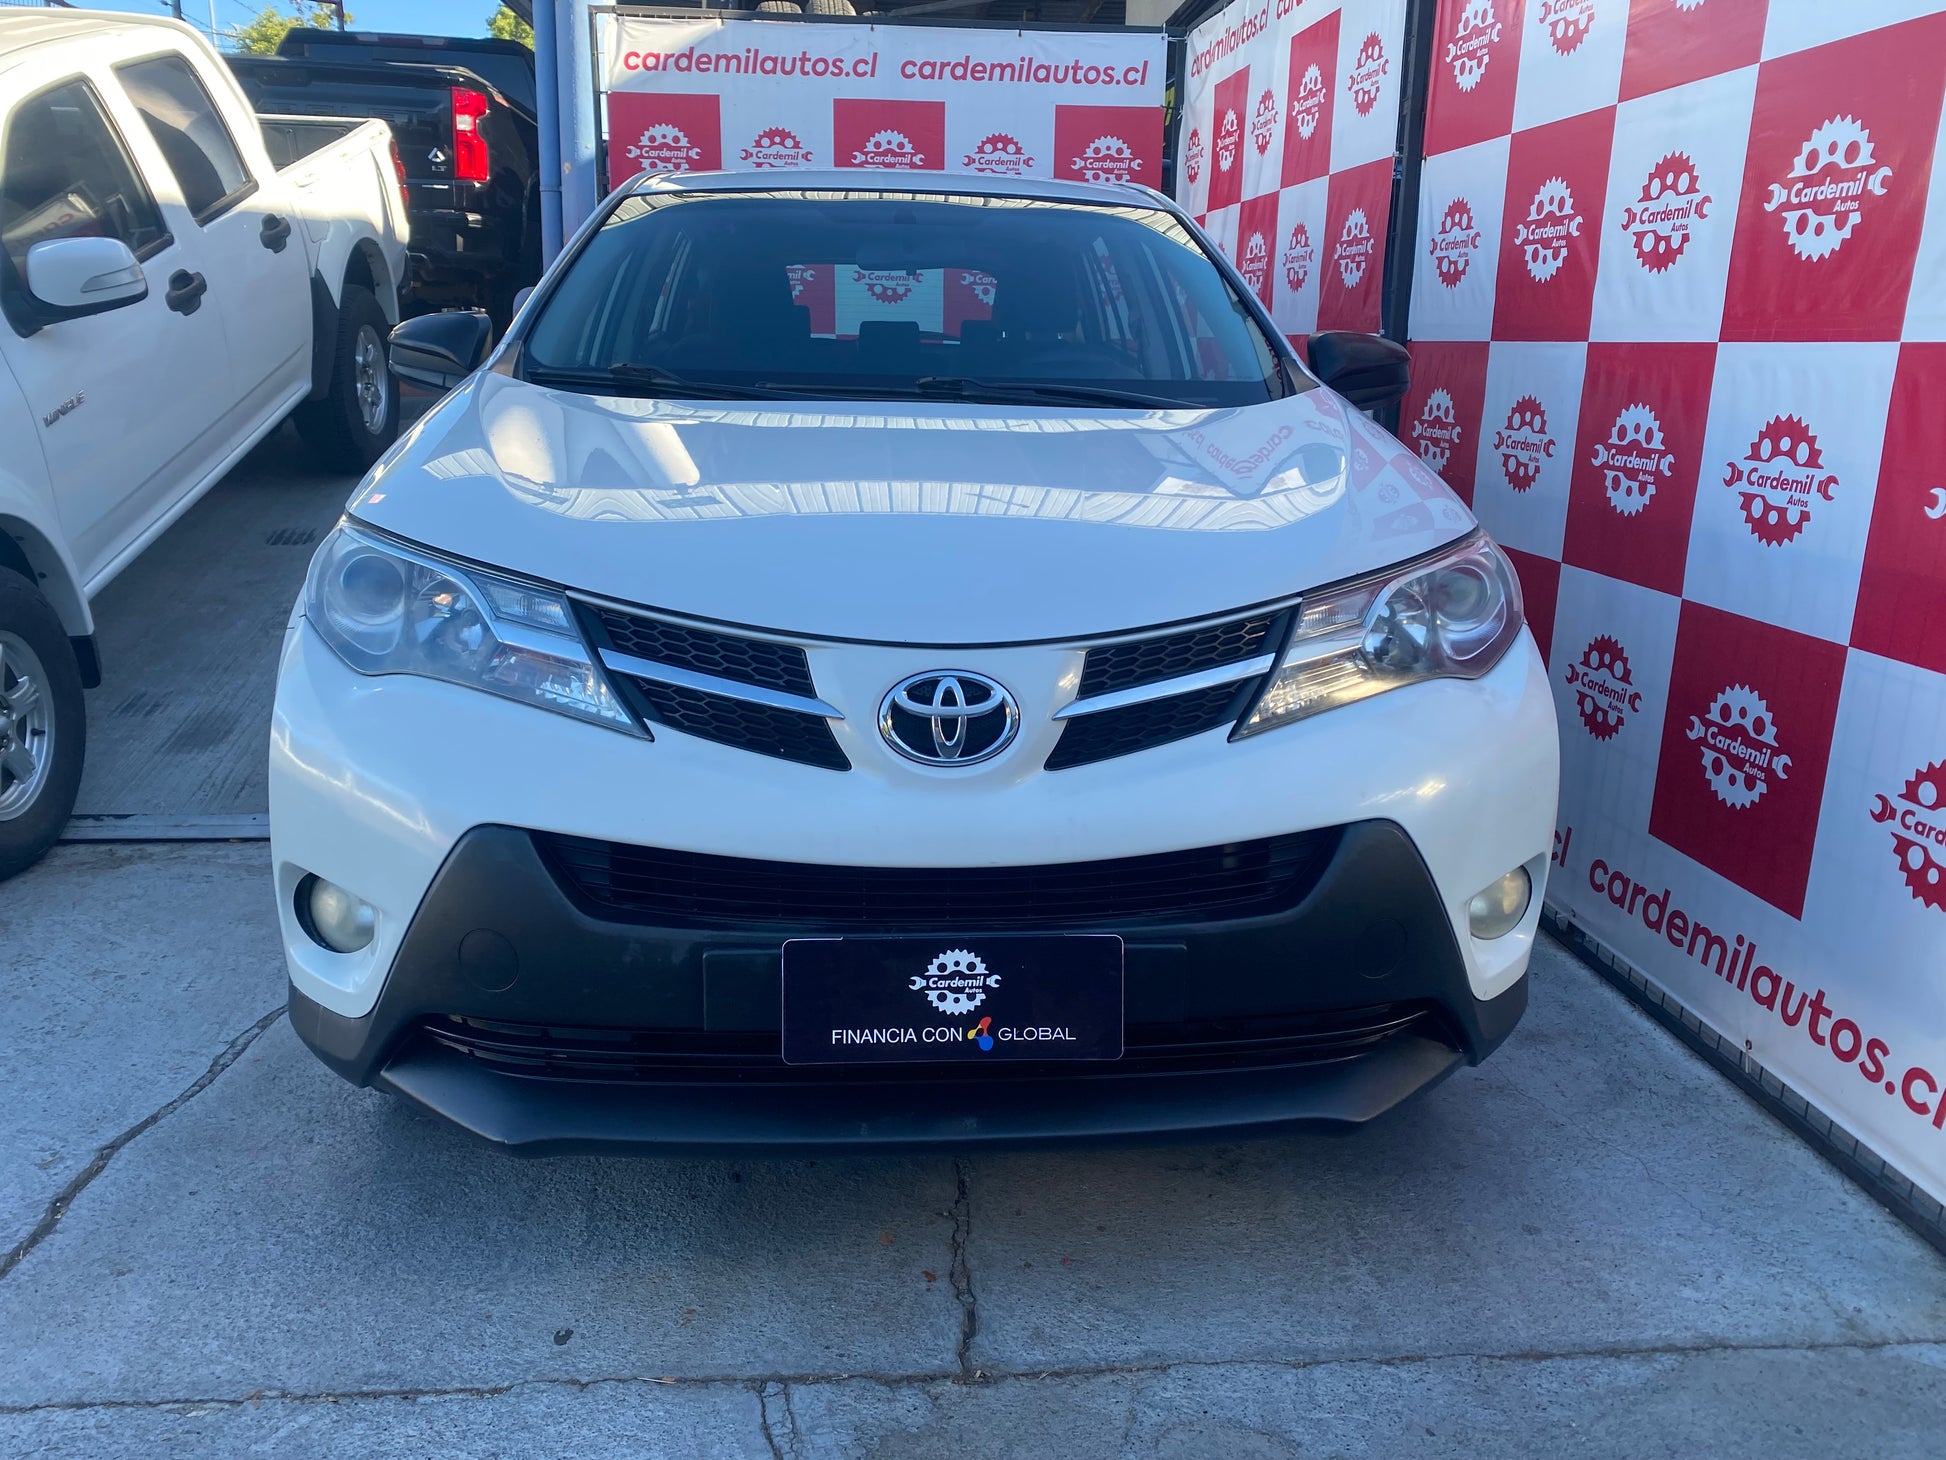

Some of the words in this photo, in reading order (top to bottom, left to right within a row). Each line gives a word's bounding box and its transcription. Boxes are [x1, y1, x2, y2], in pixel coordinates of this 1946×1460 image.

[1456, 27, 1492, 55] Cardemil
[623, 46, 878, 78] cardemilautos.cl
[900, 55, 1149, 86] cardemilautos.cl
[641, 147, 687, 158] Cardemil
[755, 150, 800, 161] Cardemil
[867, 153, 911, 164] Cardemil
[977, 155, 1021, 167] Cardemil
[1086, 158, 1129, 169] Cardemil
[1790, 171, 1867, 205] Cardemil
[1639, 199, 1691, 225] Cardemil
[1833, 200, 1859, 213] Autos
[1528, 219, 1568, 240] Cardemil
[1670, 222, 1688, 233] Autos
[1439, 234, 1470, 251] Cardemil
[1551, 239, 1566, 247] Autos
[1422, 423, 1451, 440] Cardemil
[1505, 434, 1543, 454] Cardemil
[1608, 448, 1659, 472] Cardemil
[1637, 471, 1654, 483] Autos
[1746, 467, 1815, 494] Cardemil
[1786, 496, 1808, 509] Autos
[1580, 672, 1628, 704] Cardemil
[1608, 701, 1624, 714] Autos
[1707, 726, 1771, 768] Cardemil
[1743, 762, 1765, 780] Autos
[1900, 809, 1946, 847] Card
[929, 975, 984, 988] Cardemil
[832, 1028, 917, 1044] FINANCIA
[922, 1027, 963, 1043] CON
[998, 1027, 1077, 1041] GLOBAL
